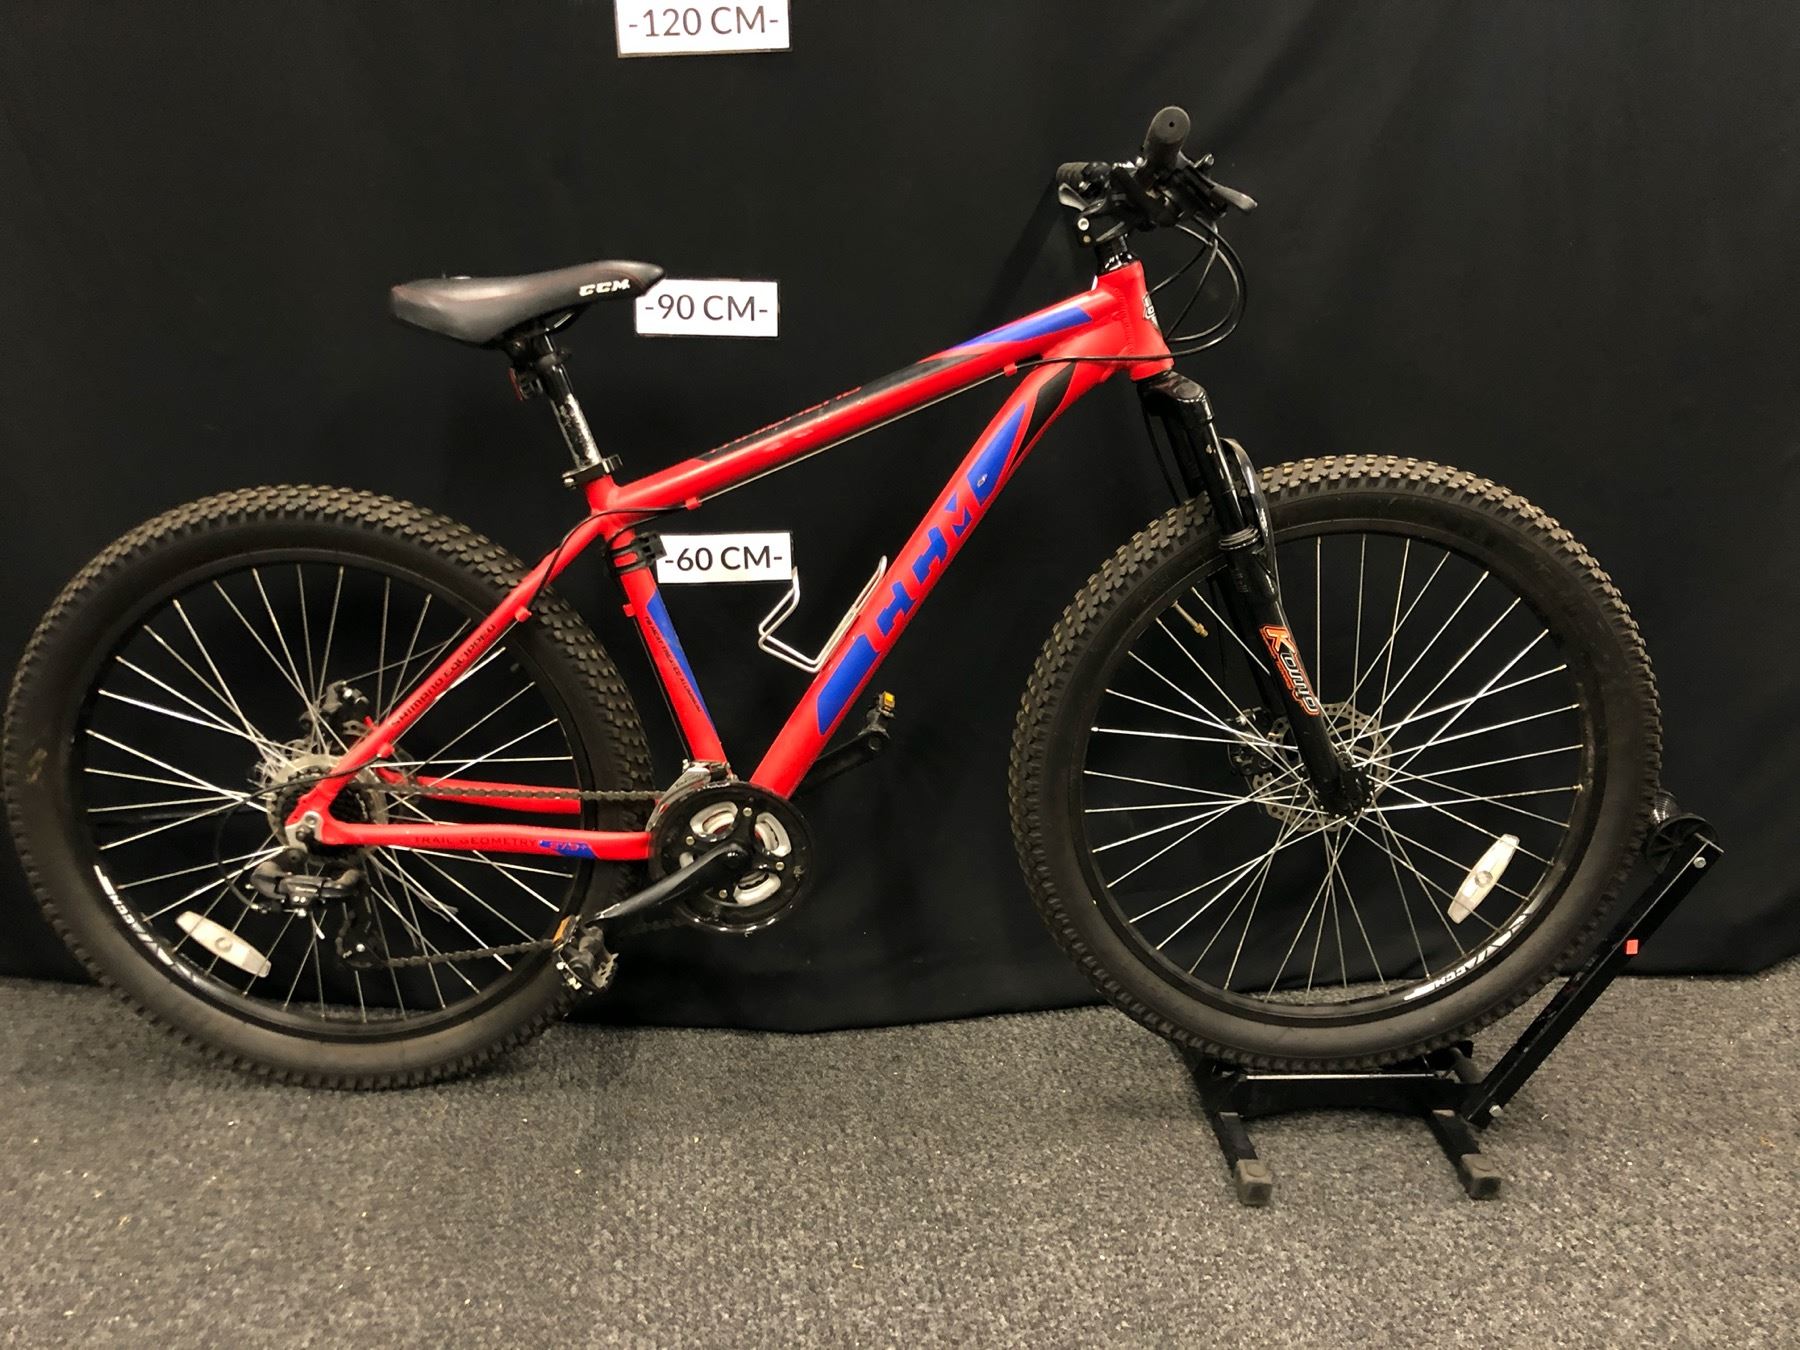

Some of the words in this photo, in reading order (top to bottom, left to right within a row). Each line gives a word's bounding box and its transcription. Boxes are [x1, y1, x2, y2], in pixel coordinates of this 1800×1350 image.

[629, 8, 702, 37] -120
[711, 6, 779, 35] CM-
[578, 278, 631, 297] CCM
[645, 294, 695, 320] -90
[703, 296, 768, 321] CM-
[665, 547, 713, 571] -60
[720, 545, 783, 570] CM-
[391, 677, 445, 727] SHIMANO
[444, 624, 497, 679] EQUIPPED
[415, 836, 452, 845] TRAIL
[459, 836, 538, 847] GEOMETRY
